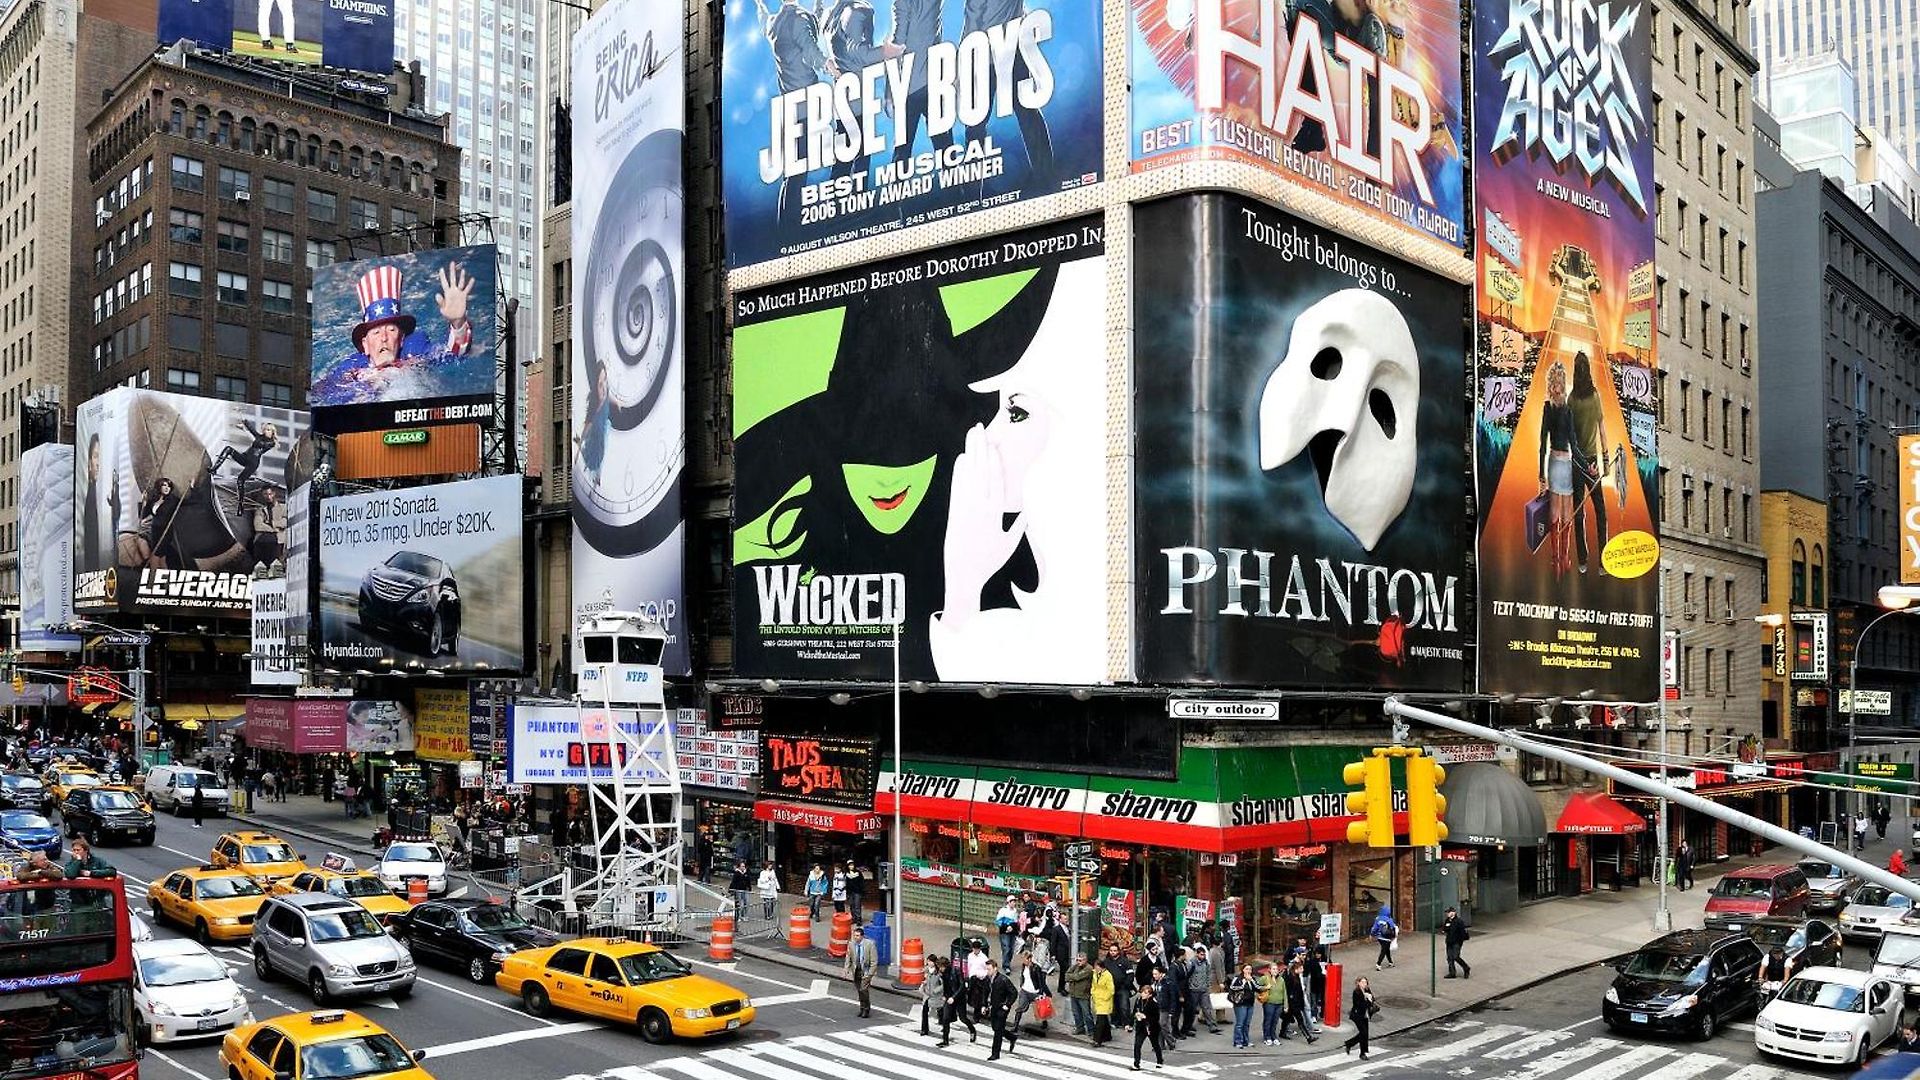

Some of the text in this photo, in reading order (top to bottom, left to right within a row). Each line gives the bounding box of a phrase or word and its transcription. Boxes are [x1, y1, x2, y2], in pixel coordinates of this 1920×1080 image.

[595, 29, 627, 73] BEING
[1559, 55, 1584, 90] OF
[759, 52, 915, 184] JERSEY
[927, 9, 1054, 136] BOYS
[1196, 0, 1435, 206] HAIR
[1490, 50, 1648, 216] AGES
[800, 139, 1002, 207] BEST MUSICAL
[1142, 120, 1194, 154] BEST
[1201, 115, 1280, 163] MUSICAL
[1284, 143, 1338, 190] REVIVAL
[1349, 175, 1382, 208] 2009
[1385, 190, 1415, 221] TONY
[1417, 207, 1459, 242] AWARD
[800, 201, 836, 225] 2006
[838, 190, 877, 215] TONY
[939, 156, 1003, 190] WINNER
[1536, 177, 1612, 219] A NEW MUSICAL
[788, 239, 822, 255] AUGUST
[824, 229, 859, 249] WILSON
[860, 219, 903, 241] THEATRE,
[905, 215, 926, 228] 245
[926, 206, 956, 222] WEST
[981, 190, 1022, 207] STREET
[1241, 207, 1412, 298] Tonight belongs to...
[394, 403, 493, 424] DEFEATTHEDEBT.COM
[324, 494, 439, 524] All-new 2011 Sonata.
[323, 511, 496, 547] 200 hp. 35 mpg. Under $20K.
[135, 597, 244, 609] PREMIERES SUNDAY JUNE 20
[1160, 546, 1458, 632] PHANTOM
[760, 625, 904, 635] THE UNTOLD STORY OF THE WITCHES OF Z
[1493, 601, 1515, 616] TEXT
[1559, 607, 1568, 621] to
[1569, 608, 1595, 624] 56543
[1596, 611, 1609, 625] for
[1609, 612, 1628, 627] FREE
[1629, 613, 1654, 629] STUFF!
[255, 644, 265, 672] IN
[323, 642, 384, 660] Hyundai.com
[1526, 640, 1549, 653] Brooks
[625, 670, 649, 683] NYPD
[1184, 703, 1266, 716] city outdoor
[527, 721, 580, 734] PHANTOM
[540, 748, 564, 759] NYC
[569, 743, 624, 766] GFTS
[768, 738, 821, 770] TAD'S
[801, 765, 867, 794] STEAKS
[888, 769, 1353, 827] sbarro sbarro sbarro sbarro sbar
[856, 816, 882, 831] TAD'S
[977, 831, 1011, 844] Espresso
[19, 929, 49, 940] 71517
